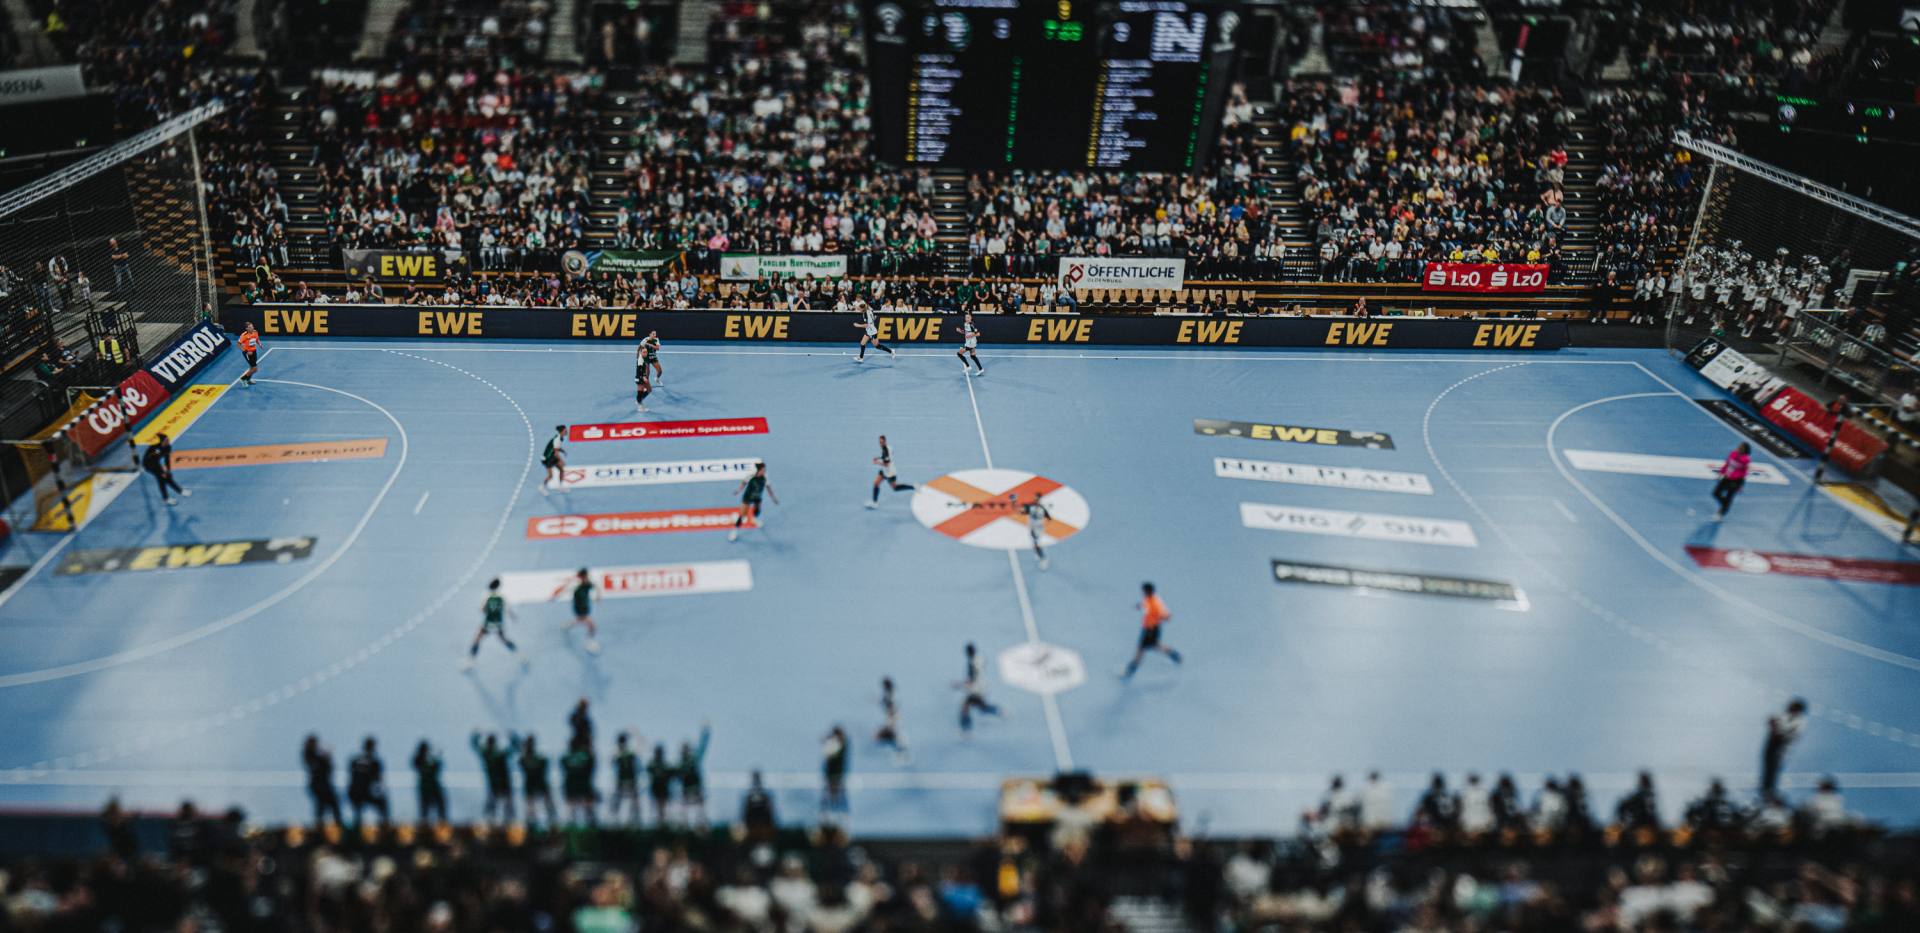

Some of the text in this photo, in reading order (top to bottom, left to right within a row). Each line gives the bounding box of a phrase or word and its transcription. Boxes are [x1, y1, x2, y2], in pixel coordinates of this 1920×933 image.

[381, 255, 436, 277] EWE
[1088, 264, 1176, 278] ÖFFENTLICHE
[1451, 271, 1481, 287] LzO
[1512, 272, 1543, 287] LzO
[264, 310, 329, 333] EWE
[418, 312, 483, 335] EWE
[571, 314, 637, 337] EWE
[725, 315, 790, 339] EWE
[876, 318, 943, 341] EWE
[1027, 319, 1094, 342] EWE
[1176, 321, 1244, 343] EWE
[1325, 323, 1393, 345] EWE
[1472, 325, 1541, 347] EWE
[151, 326, 224, 384] VIEROL
[609, 427, 646, 437] LzO
[1251, 424, 1338, 445] EWE
[595, 462, 752, 477] ÖFFENTLICHE
[129, 542, 253, 571] EWE
